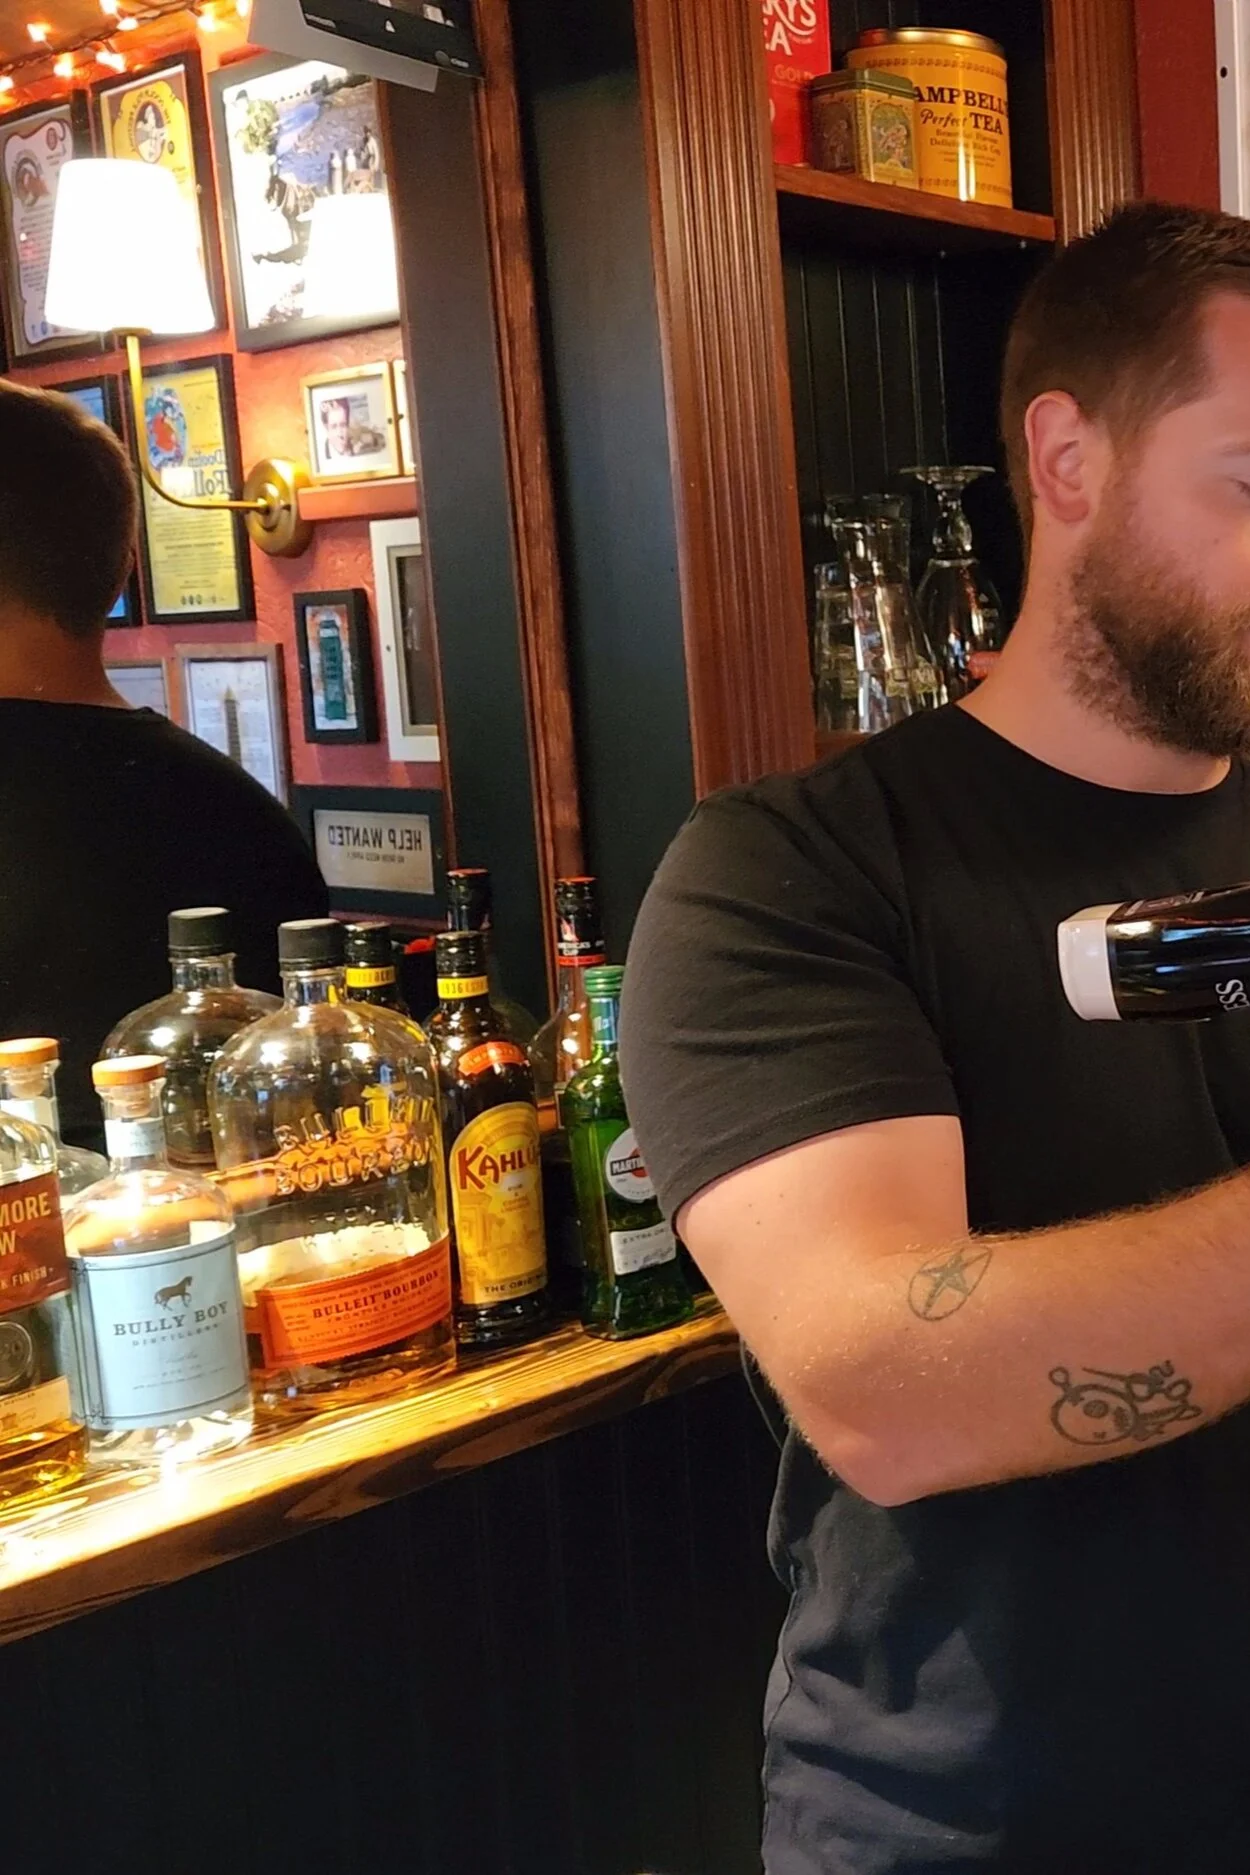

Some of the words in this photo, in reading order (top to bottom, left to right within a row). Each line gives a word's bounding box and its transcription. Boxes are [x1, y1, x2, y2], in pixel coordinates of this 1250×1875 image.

[920, 108, 967, 128] Perfect
[970, 112, 1003, 135] TEA
[12, 1266, 47, 1287] FINISH
[484, 1282, 505, 1294] THE
[113, 1314, 187, 1337] BULLY
[194, 1299, 230, 1323] BOY
